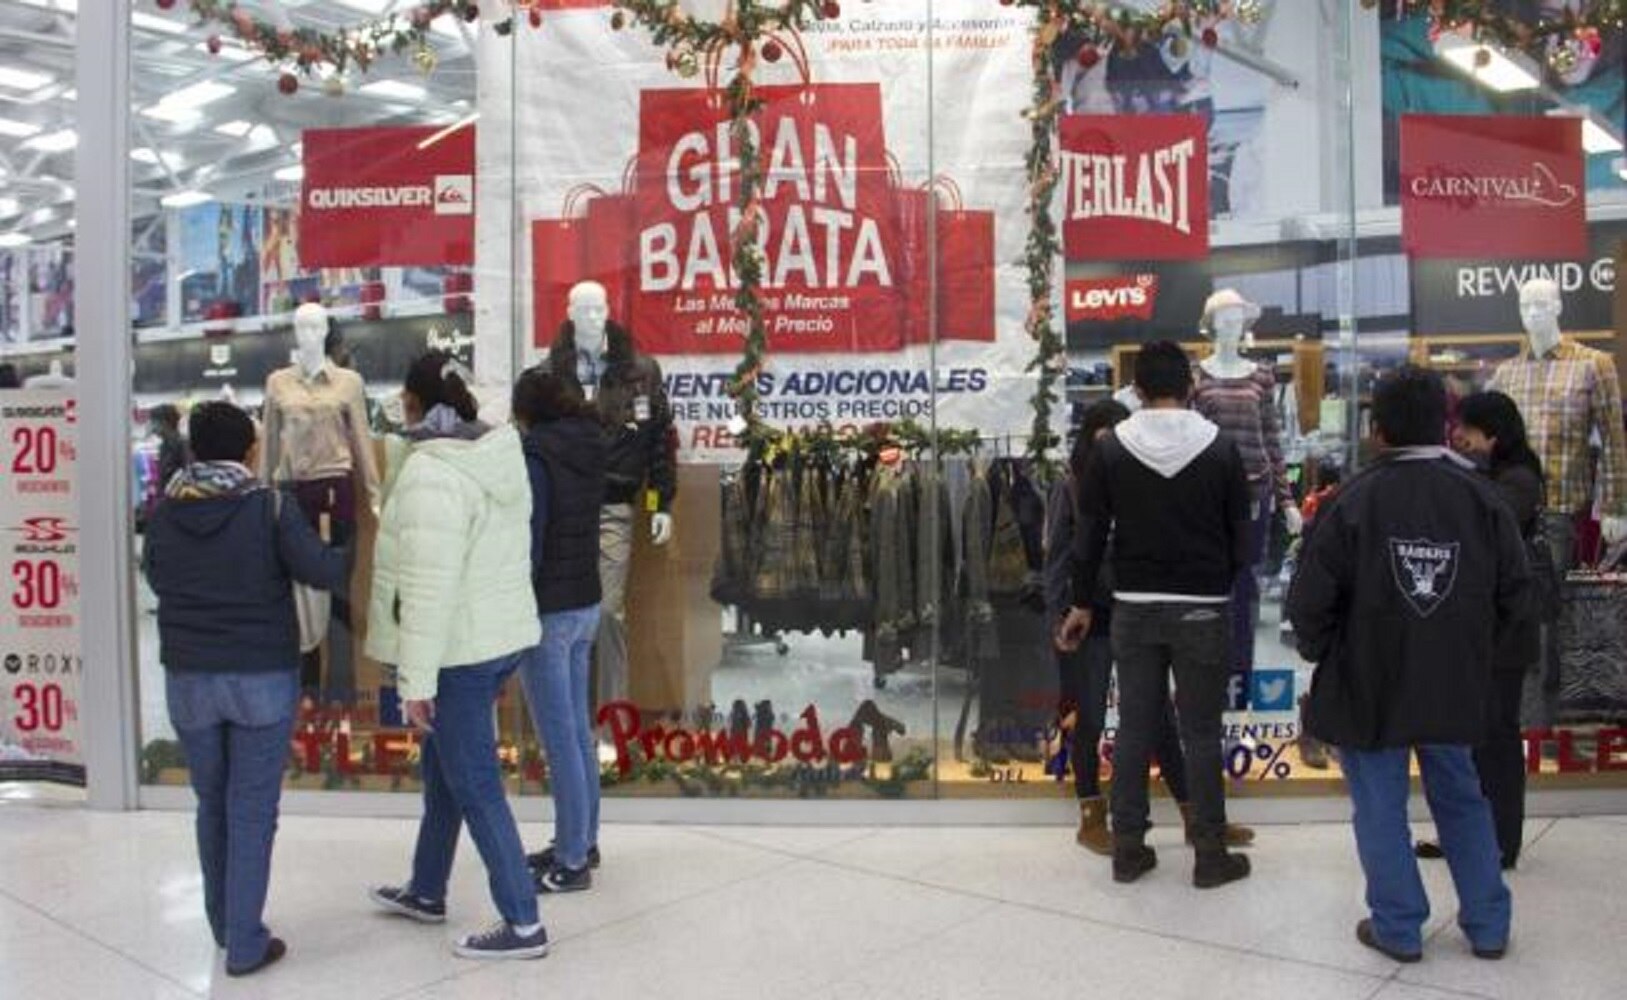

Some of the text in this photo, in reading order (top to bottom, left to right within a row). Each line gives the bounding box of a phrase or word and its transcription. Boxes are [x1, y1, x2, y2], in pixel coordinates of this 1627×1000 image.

[308, 187, 432, 209] QUIKSILVER
[1410, 176, 1531, 197] CARNIVAL
[674, 296, 706, 313] Las
[784, 294, 849, 311] Marcas
[695, 314, 834, 337] al Mejr Precio
[707, 401, 829, 420] NUSTROS
[291, 730, 422, 775] TLE
[597, 700, 868, 782] Promoda
[1519, 728, 1627, 775] TLE
[1223, 743, 1292, 781] 0%
